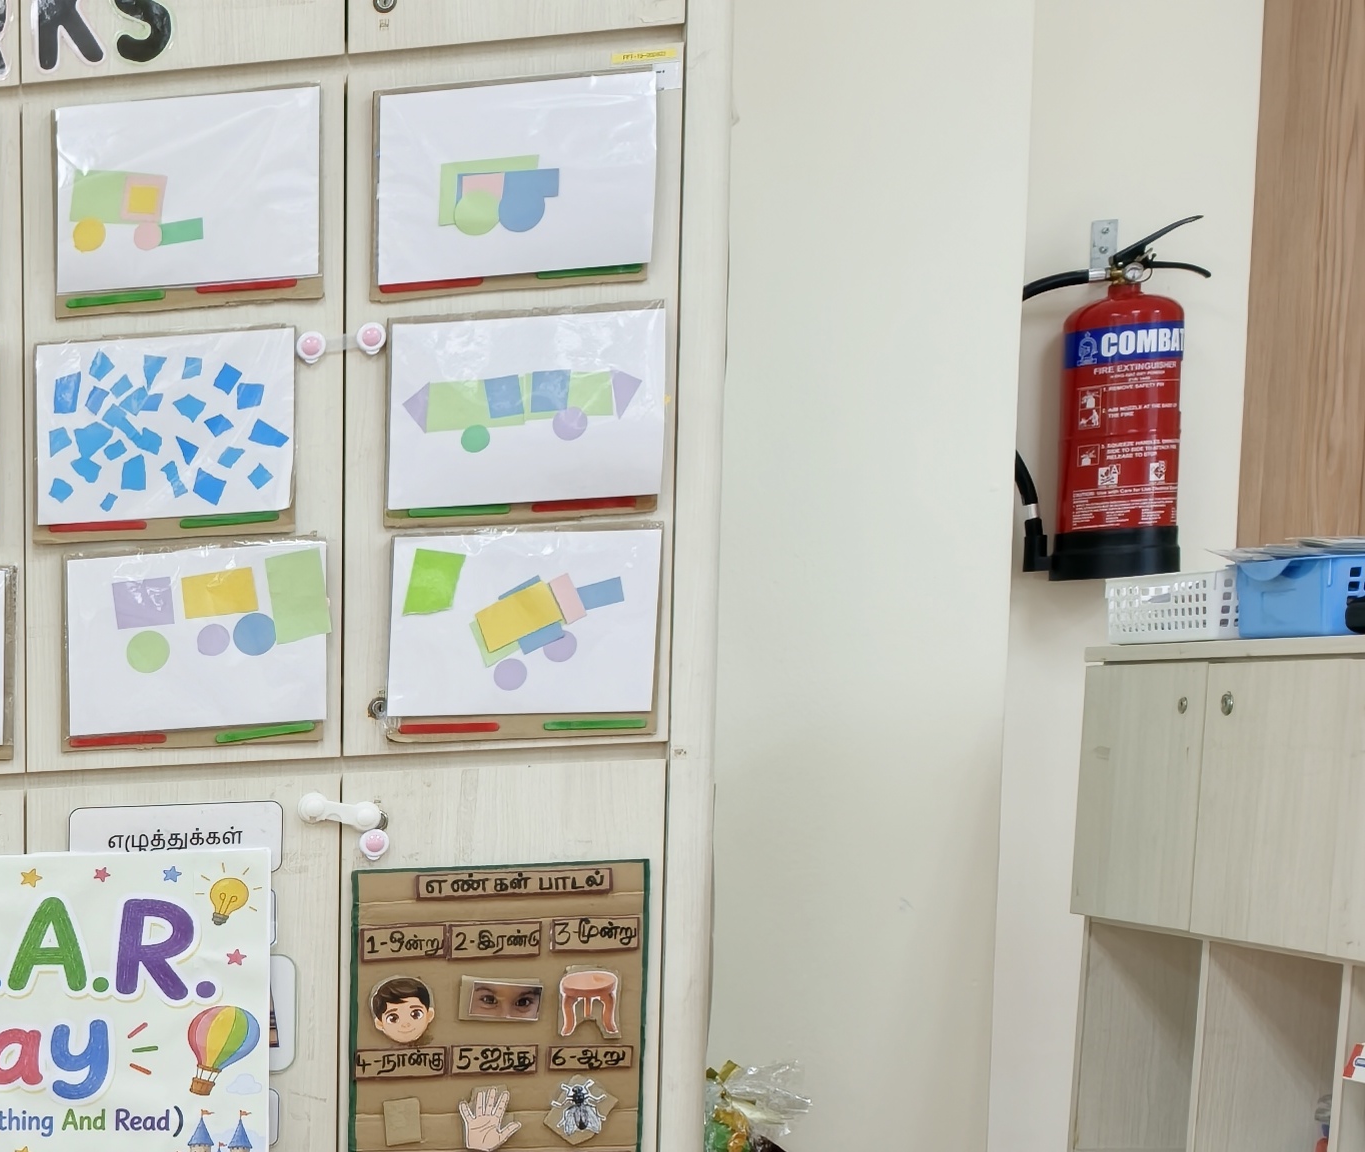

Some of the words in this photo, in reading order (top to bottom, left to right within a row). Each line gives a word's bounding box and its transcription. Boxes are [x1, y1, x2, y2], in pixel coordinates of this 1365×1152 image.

[1101, 327, 1184, 357] COMBAT
[1093, 366, 1115, 375] FIRE
[1117, 361, 1177, 373] EXTINGUISHER
[107, 827, 243, 852] எழுத்துக்கள்
[538, 870, 604, 892] பாடல்
[61, 1109, 107, 1132] And
[115, 1106, 184, 1138] Read)
